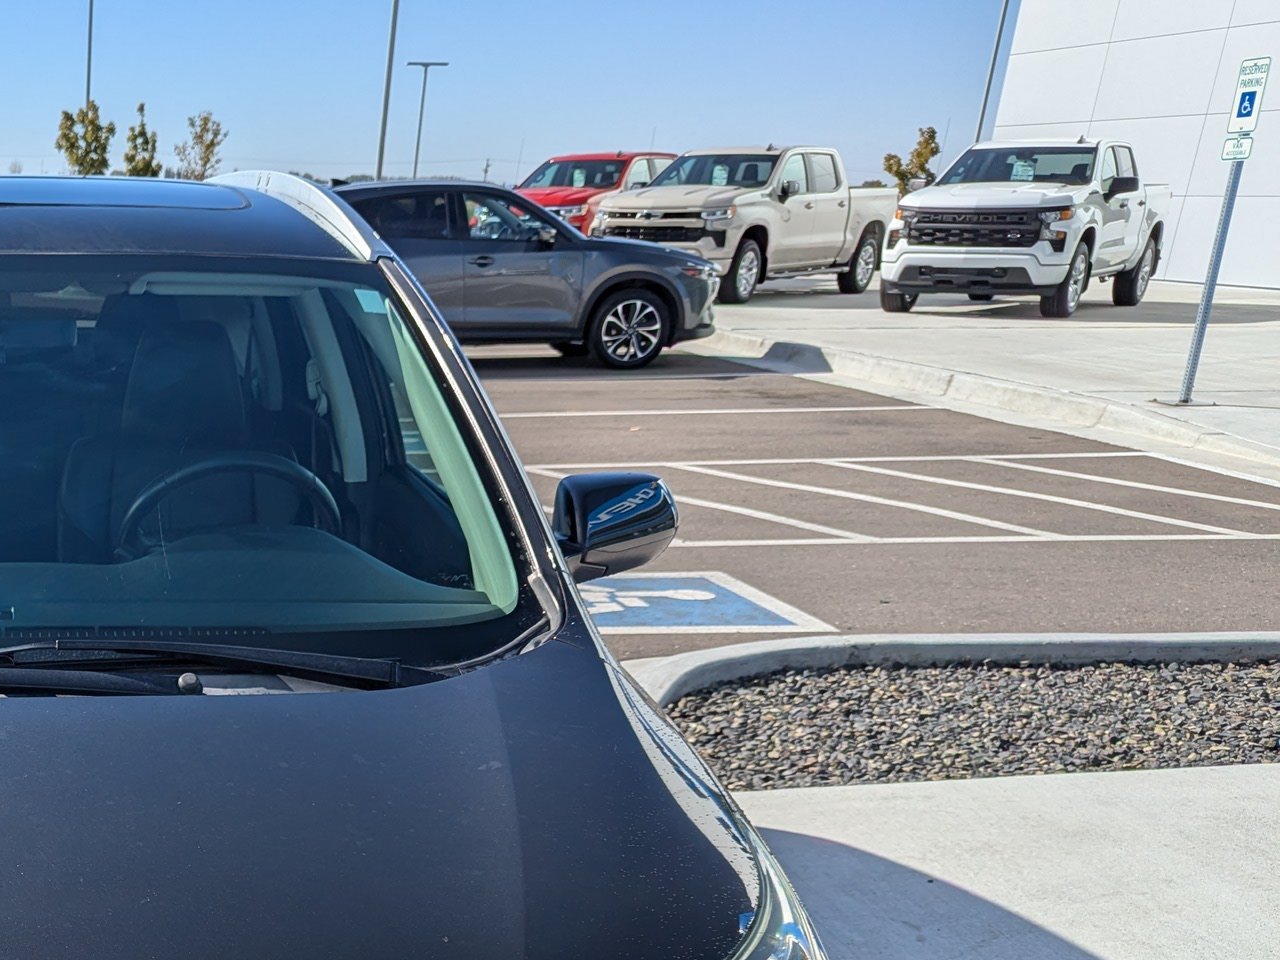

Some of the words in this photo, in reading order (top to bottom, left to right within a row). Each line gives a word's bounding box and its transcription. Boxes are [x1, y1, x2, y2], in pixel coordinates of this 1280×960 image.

[1240, 64, 1269, 75] RESERVED
[1239, 76, 1264, 88] PARKING
[917, 213, 1028, 223] CHEVROLET
